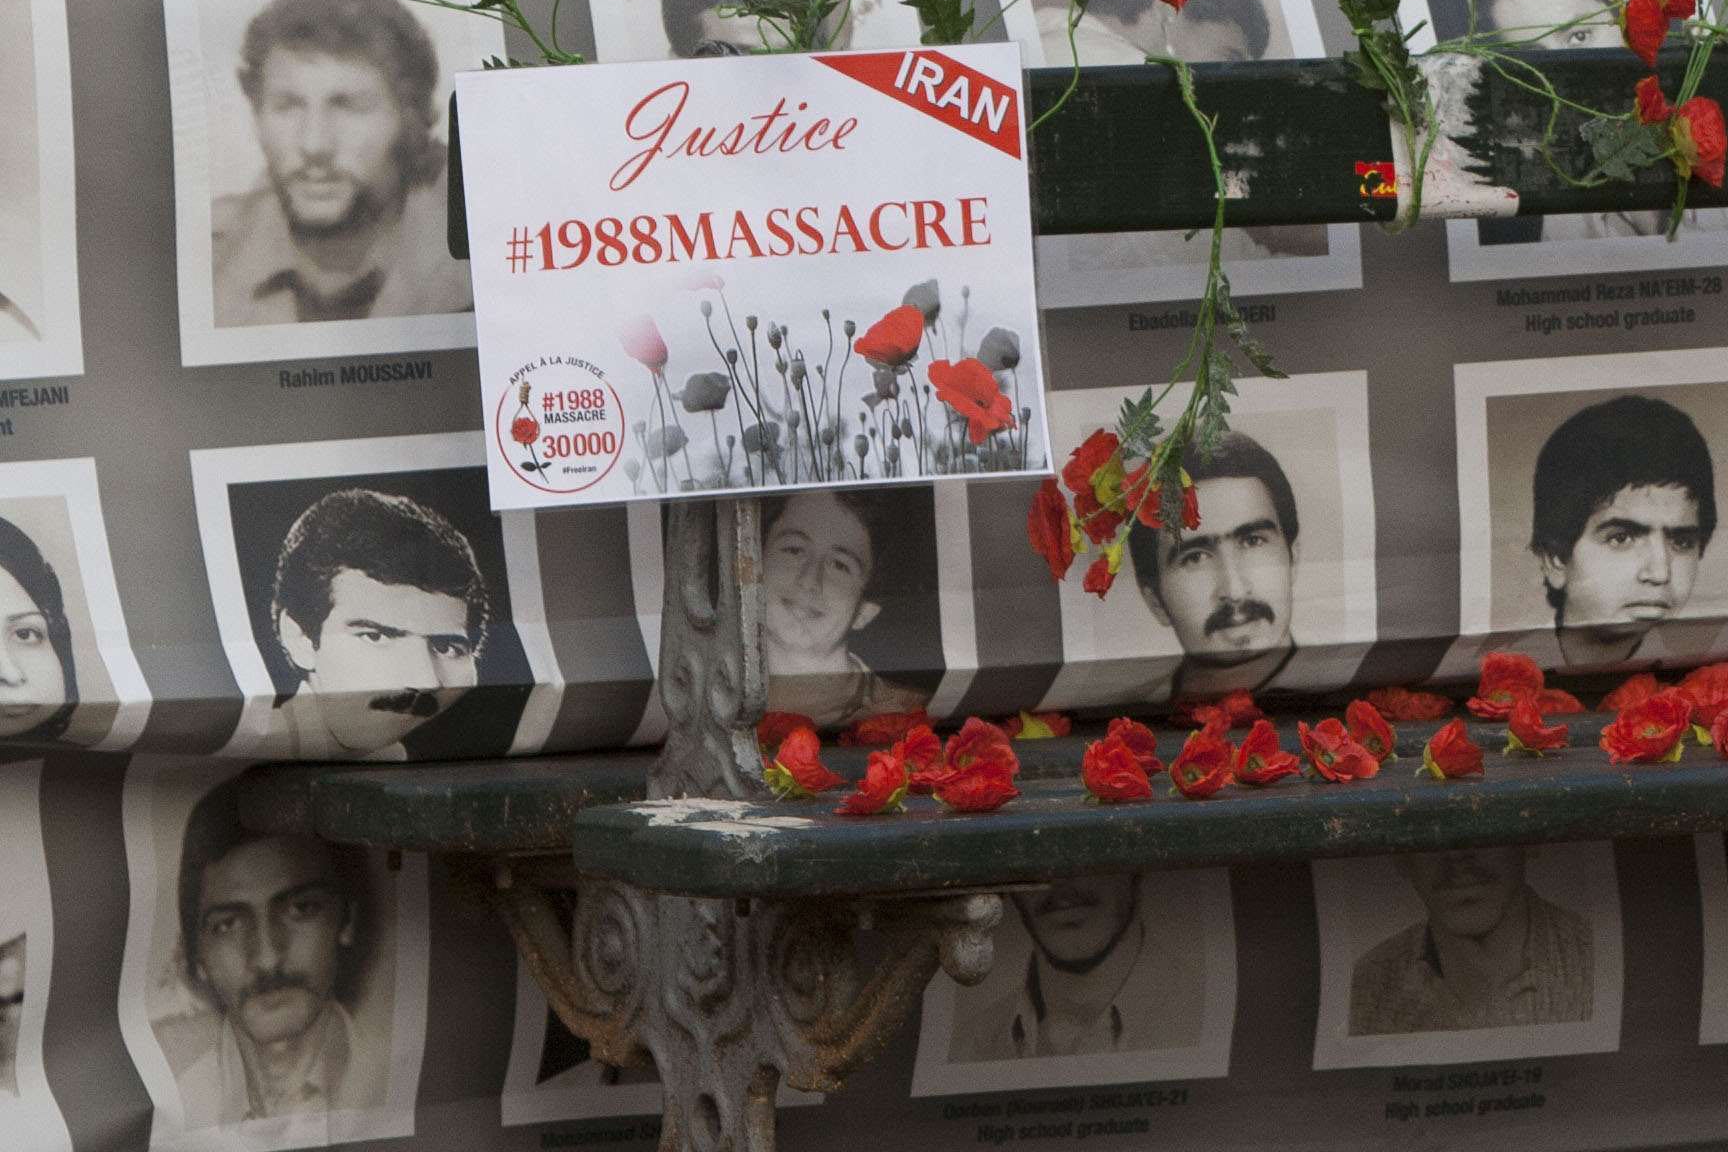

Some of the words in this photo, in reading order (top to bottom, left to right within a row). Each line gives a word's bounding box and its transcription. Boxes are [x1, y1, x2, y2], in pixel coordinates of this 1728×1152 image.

[894, 50, 1009, 134] IRAN
[609, 80, 859, 192] Justice
[505, 196, 993, 275] #1988MASSACRE
[1496, 286, 1591, 307] Mohammad
[1595, 282, 1635, 301] Reza
[1129, 310, 1200, 331] Ebadolla
[1525, 314, 1562, 336] High
[1565, 310, 1619, 330] school
[1623, 306, 1696, 331] graduate
[279, 368, 335, 389] Rahim
[339, 361, 433, 385] MOUSSAVI
[510, 362, 537, 385] APPEL
[539, 356, 547, 366] À
[549, 356, 563, 365] LA
[565, 356, 605, 379] JUSTICE
[542, 388, 605, 412] #1988
[544, 409, 606, 424] MASSACRE
[1385, 1101, 1420, 1121] High
[1424, 1099, 1475, 1117] school
[1477, 1093, 1547, 1116] graduate
[977, 1124, 1014, 1145] High
[1017, 1121, 1073, 1140] school
[1075, 1117, 1149, 1139] graduate
